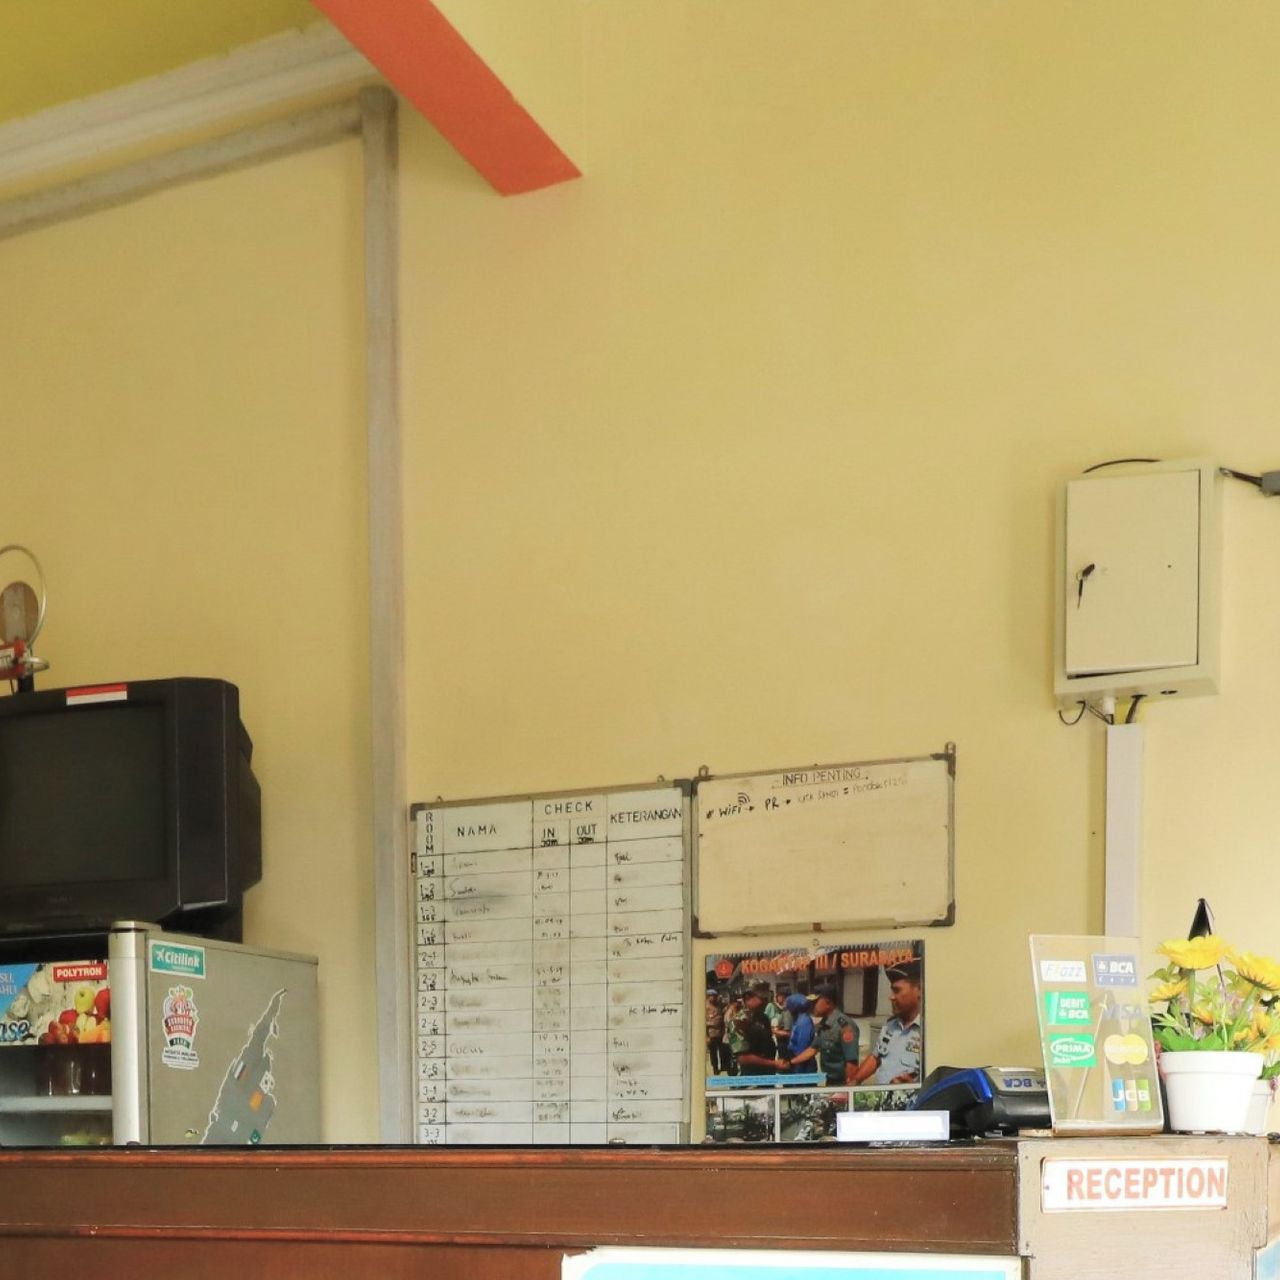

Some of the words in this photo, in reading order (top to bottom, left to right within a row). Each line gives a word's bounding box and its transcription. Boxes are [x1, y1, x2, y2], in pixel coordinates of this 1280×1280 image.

[544, 801, 593, 816] CHECK
[610, 807, 682, 825] KETERANGAN
[456, 823, 498, 838] NAMA
[542, 827, 556, 839] IN
[576, 823, 598, 836] OUT
[56, 966, 102, 978] POLYTRON
[1109, 961, 1134, 974] BCA
[1059, 998, 1085, 1010] DEBIT
[1068, 1009, 1089, 1020] BCA
[1055, 1043, 1092, 1054] PRIMA
[1065, 1166, 1227, 1201] RECEPTION
